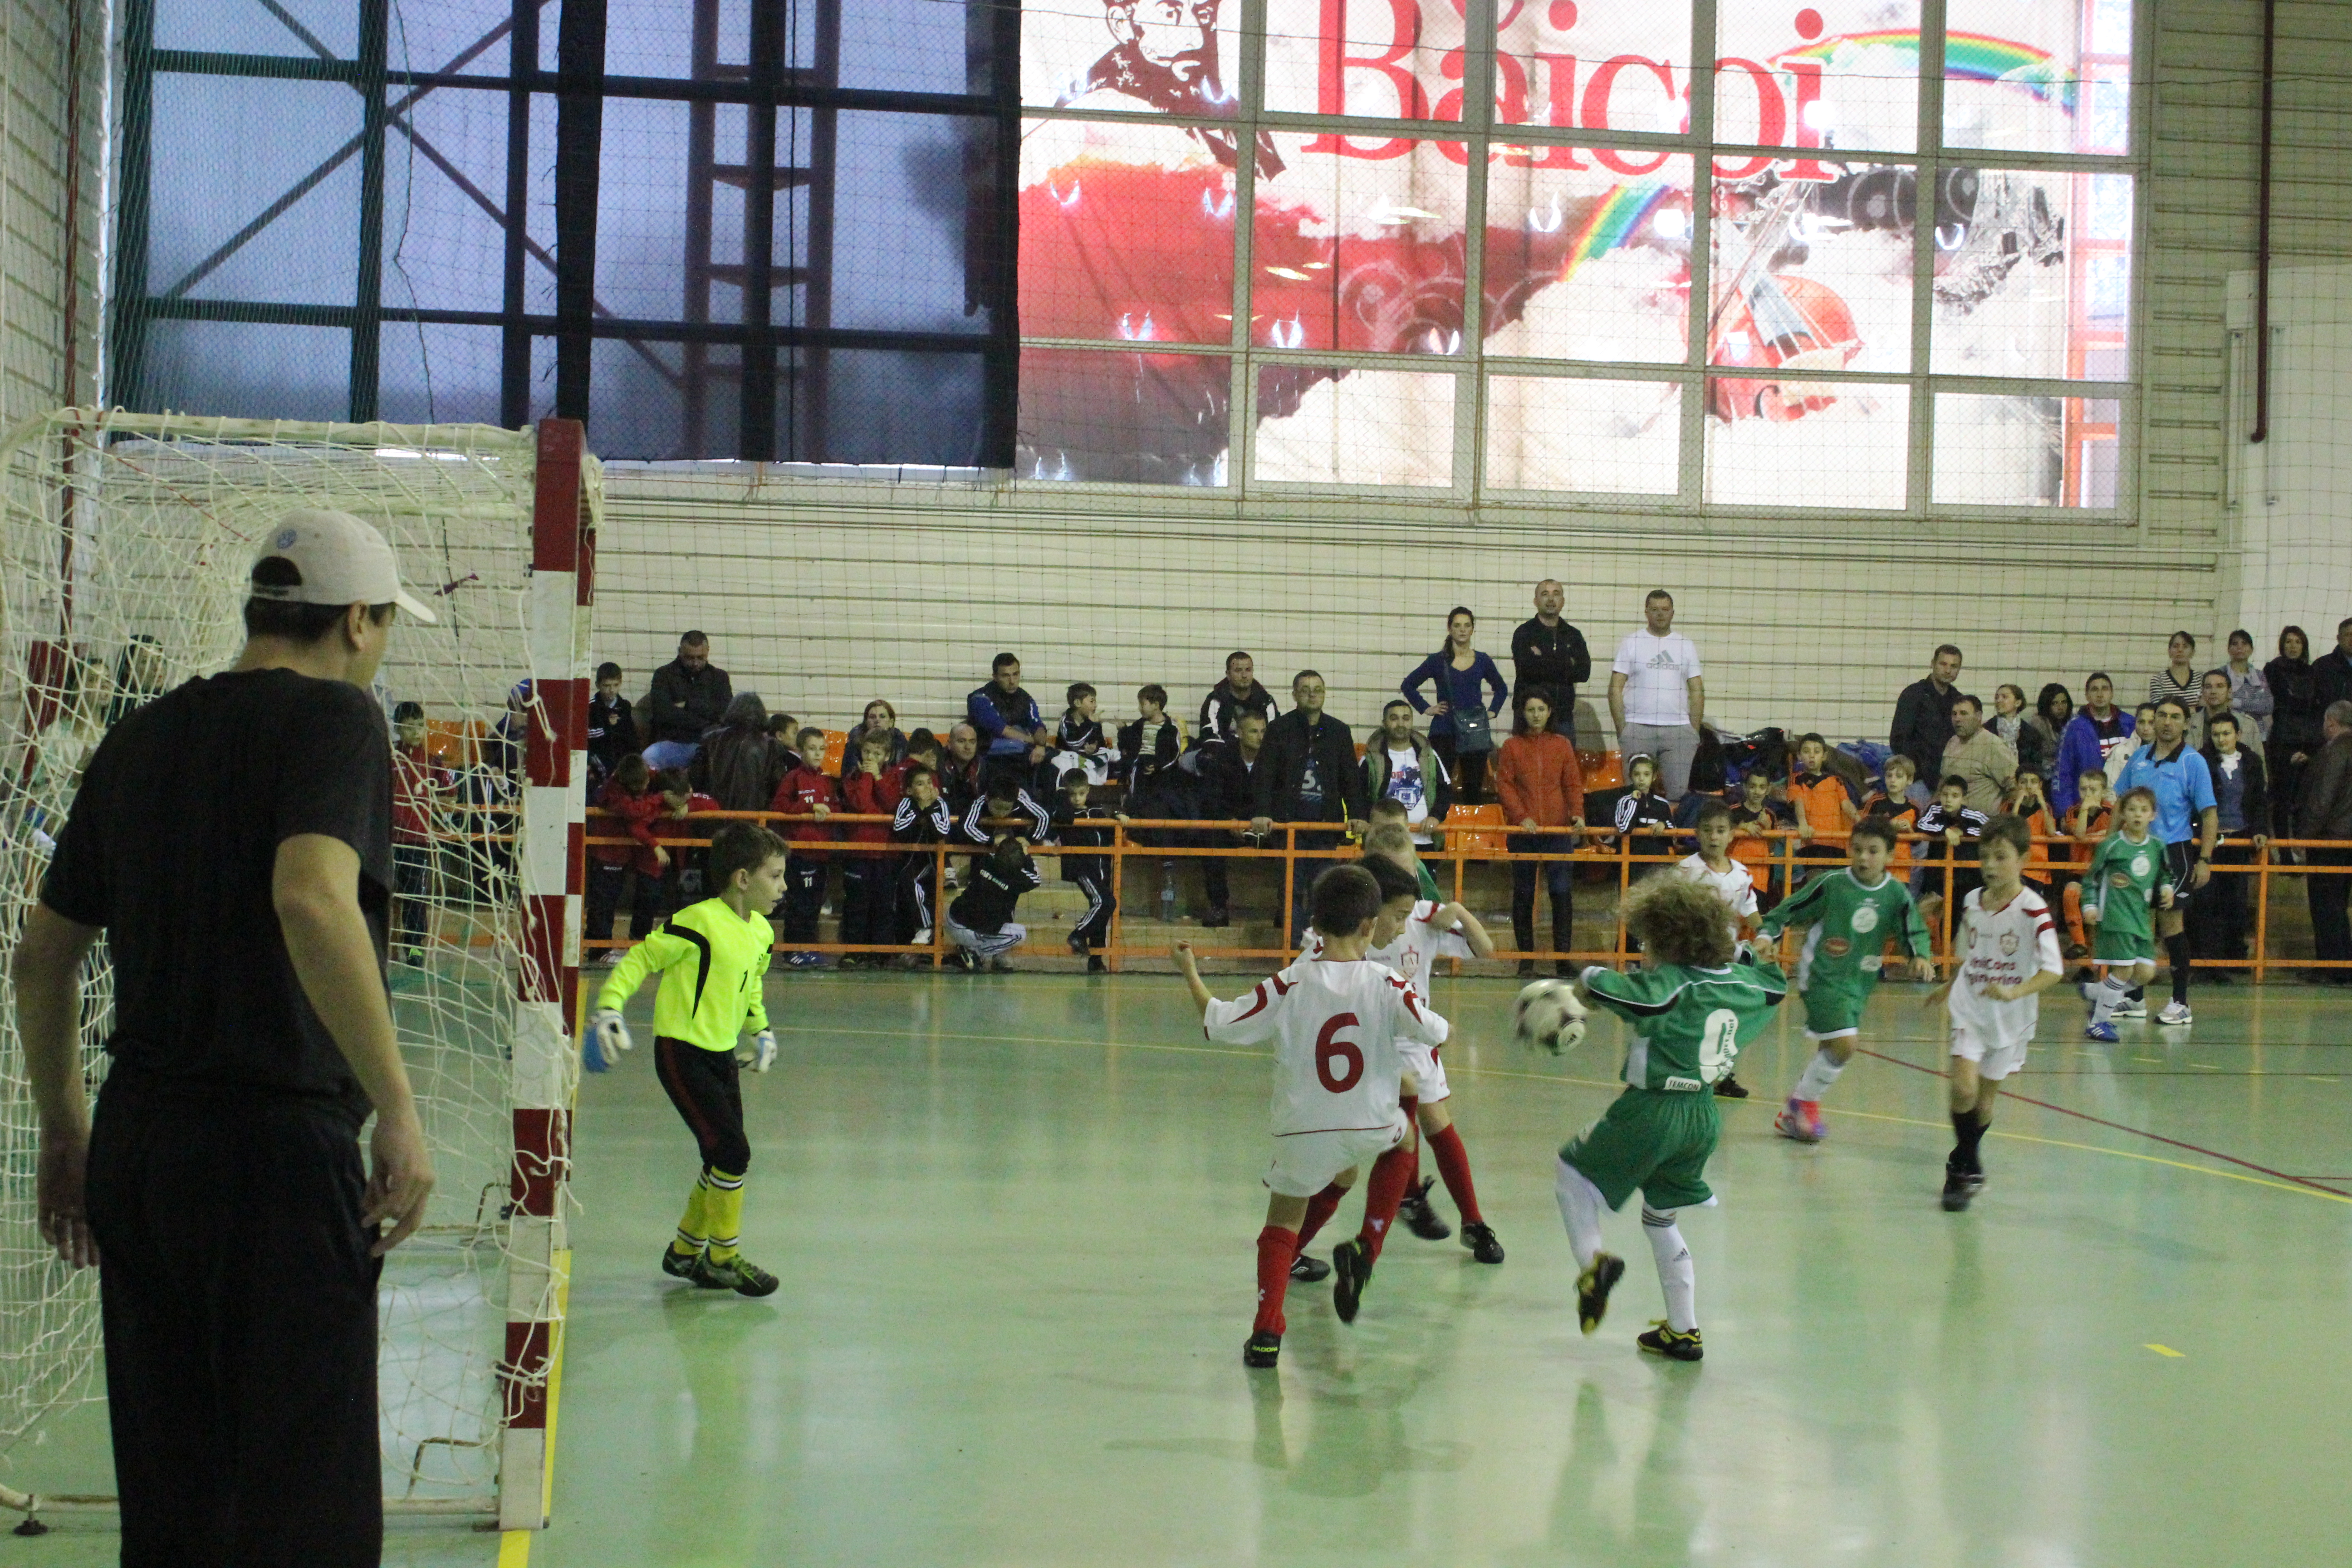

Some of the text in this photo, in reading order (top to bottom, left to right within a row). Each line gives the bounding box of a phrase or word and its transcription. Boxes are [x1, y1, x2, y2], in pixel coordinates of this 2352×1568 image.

[1646, 662, 1680, 671] adidas
[804, 795, 813, 804] 11
[803, 877, 813, 887] 11
[739, 969, 748, 993] 1
[1315, 1012, 1364, 1093] 6
